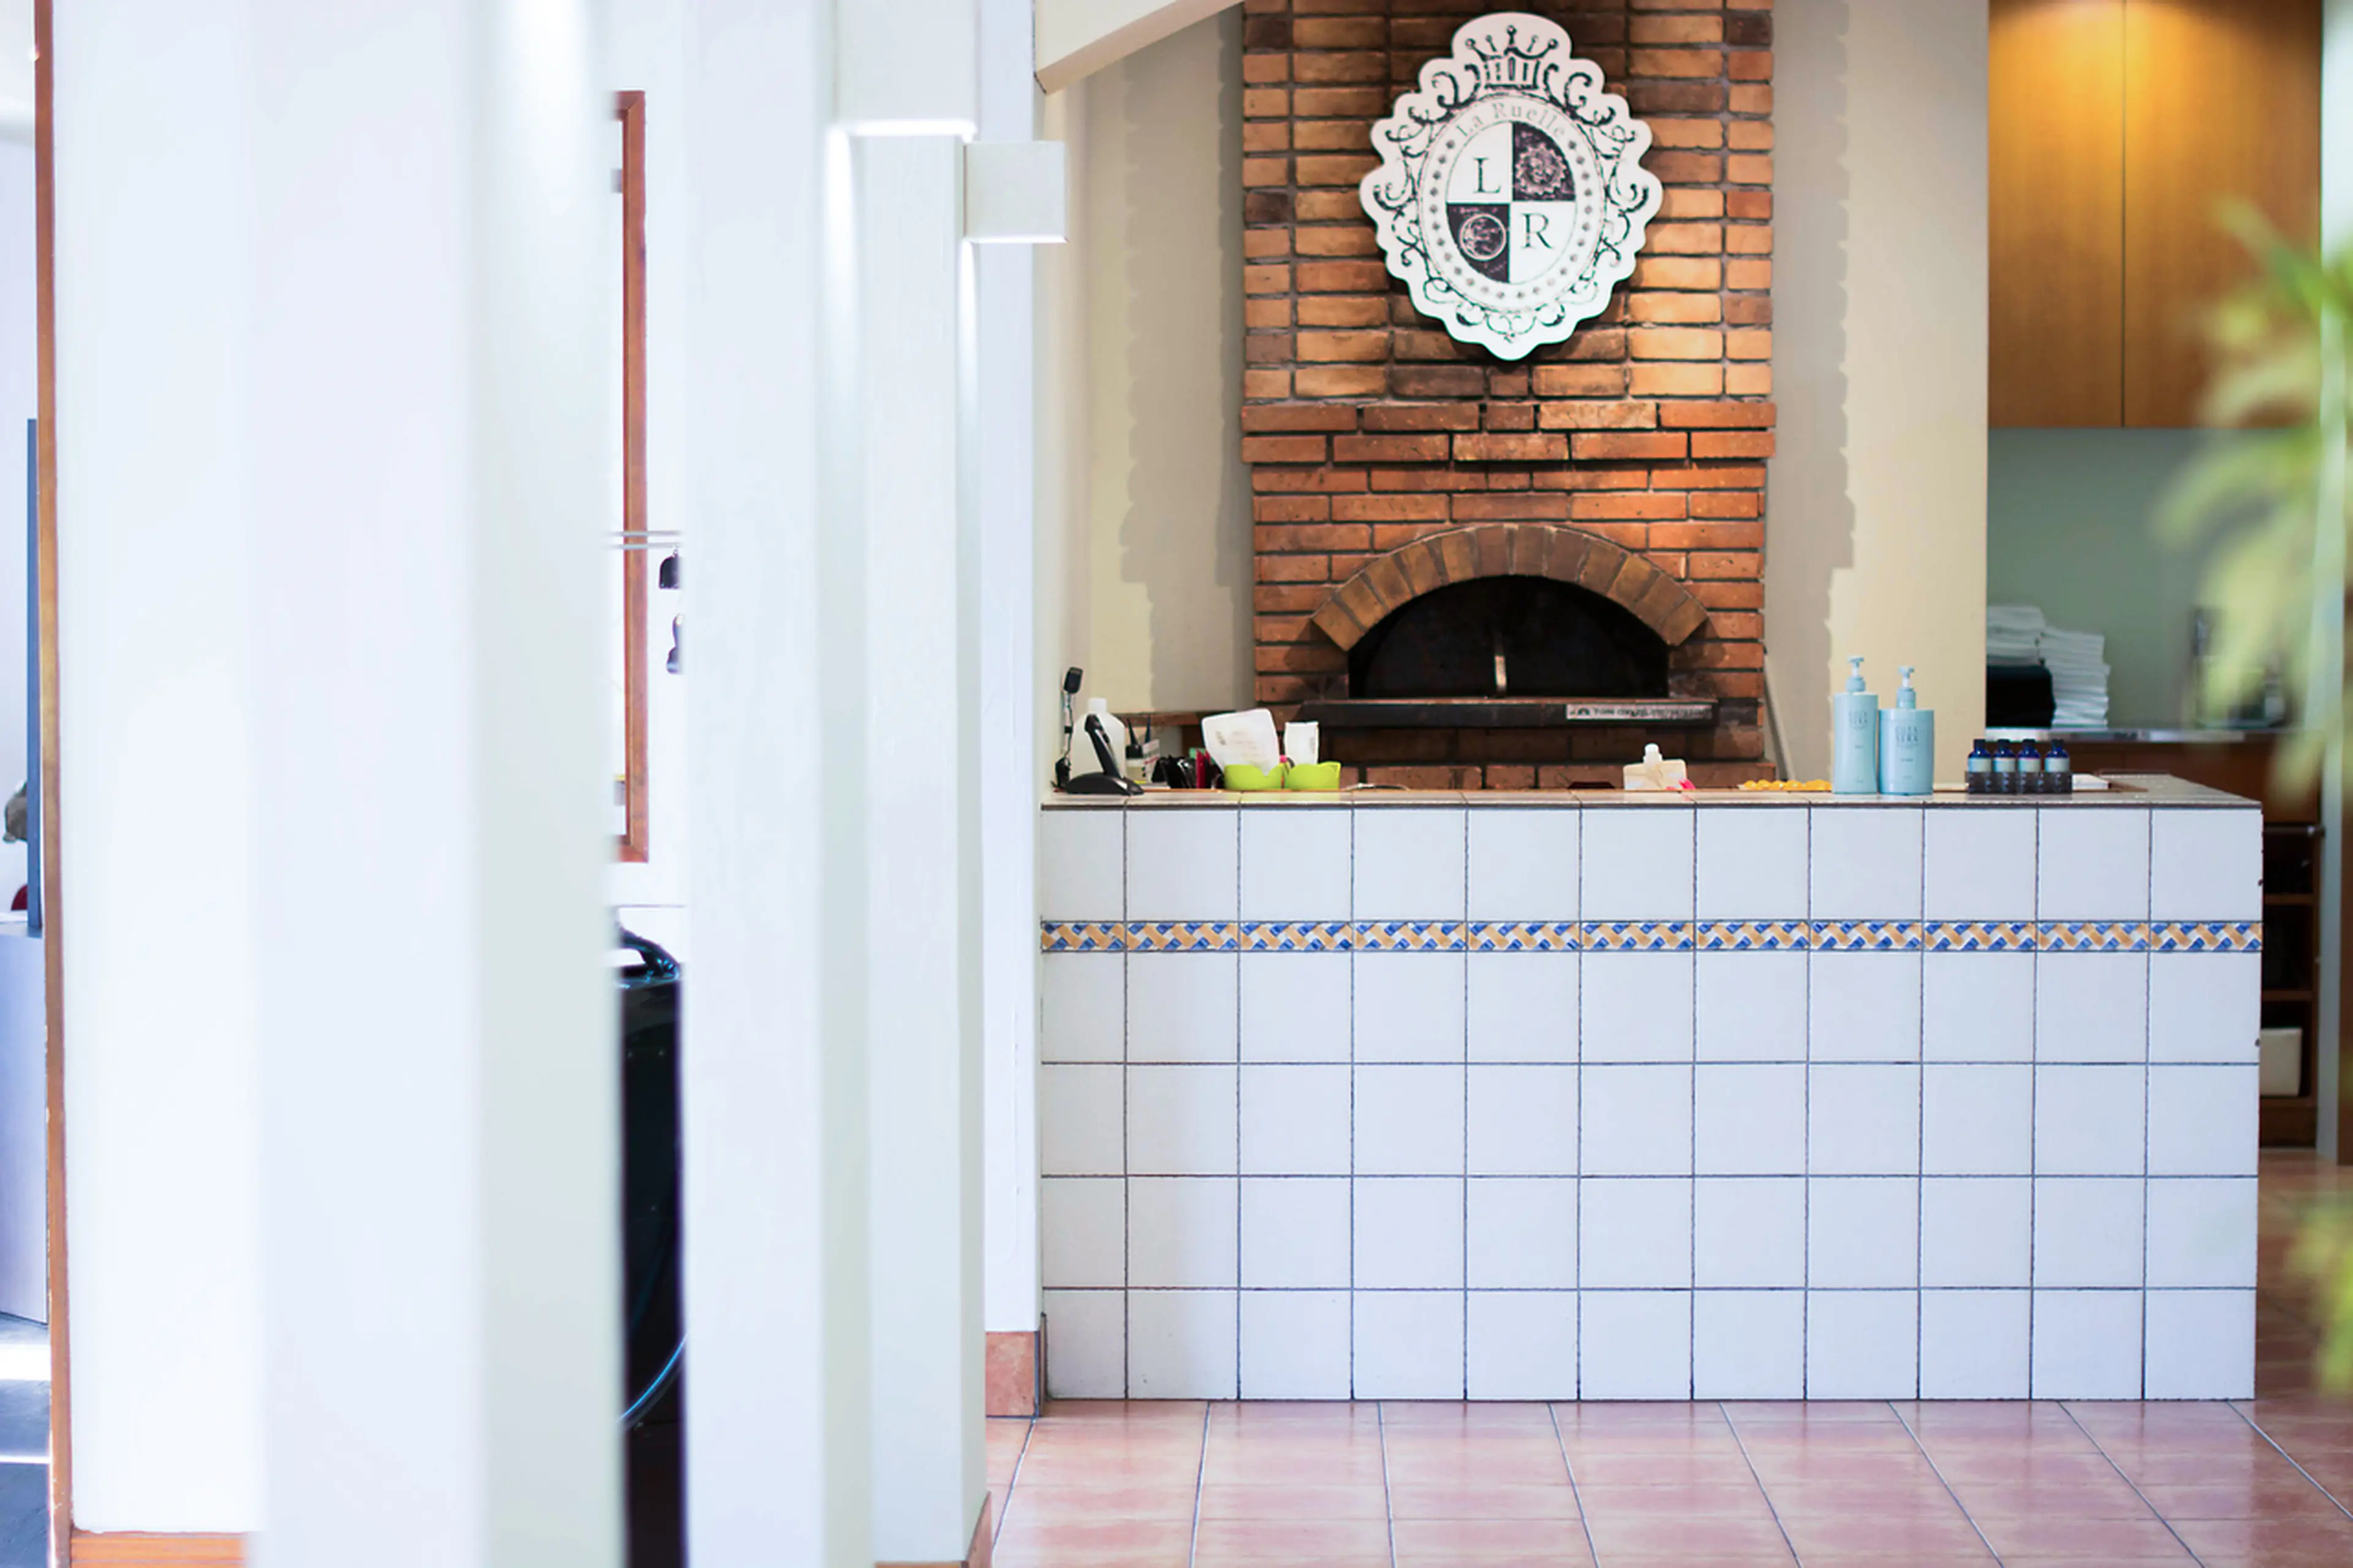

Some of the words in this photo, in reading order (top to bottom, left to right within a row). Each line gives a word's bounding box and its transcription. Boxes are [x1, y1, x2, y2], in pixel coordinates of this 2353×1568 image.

[1456, 115, 1483, 137] La
[1492, 102, 1565, 138] Ruelle
[1473, 157, 1501, 194] L
[1521, 213, 1555, 249] R
